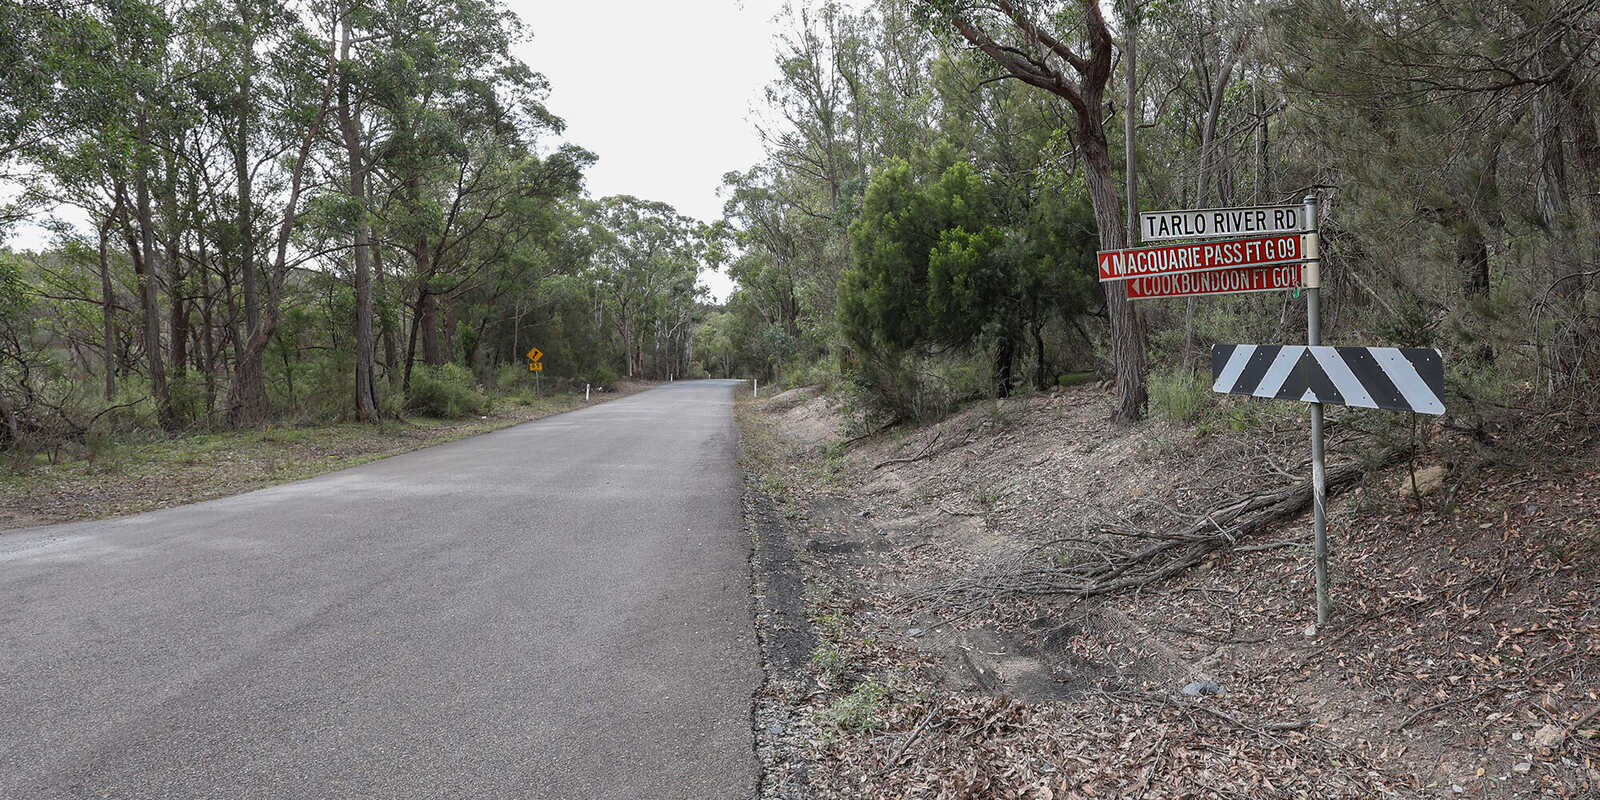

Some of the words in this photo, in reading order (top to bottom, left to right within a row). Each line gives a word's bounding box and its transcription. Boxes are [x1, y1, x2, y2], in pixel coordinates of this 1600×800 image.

[1146, 213, 1206, 237] TARLO
[1214, 210, 1267, 234] RIVER
[1274, 209, 1297, 230] RD
[1112, 246, 1202, 275] MACQUARIE
[1204, 242, 1243, 266] PASS
[1246, 240, 1262, 261] FT
[1143, 271, 1250, 296] COOKBUNDOON
[1252, 268, 1269, 289] FT
